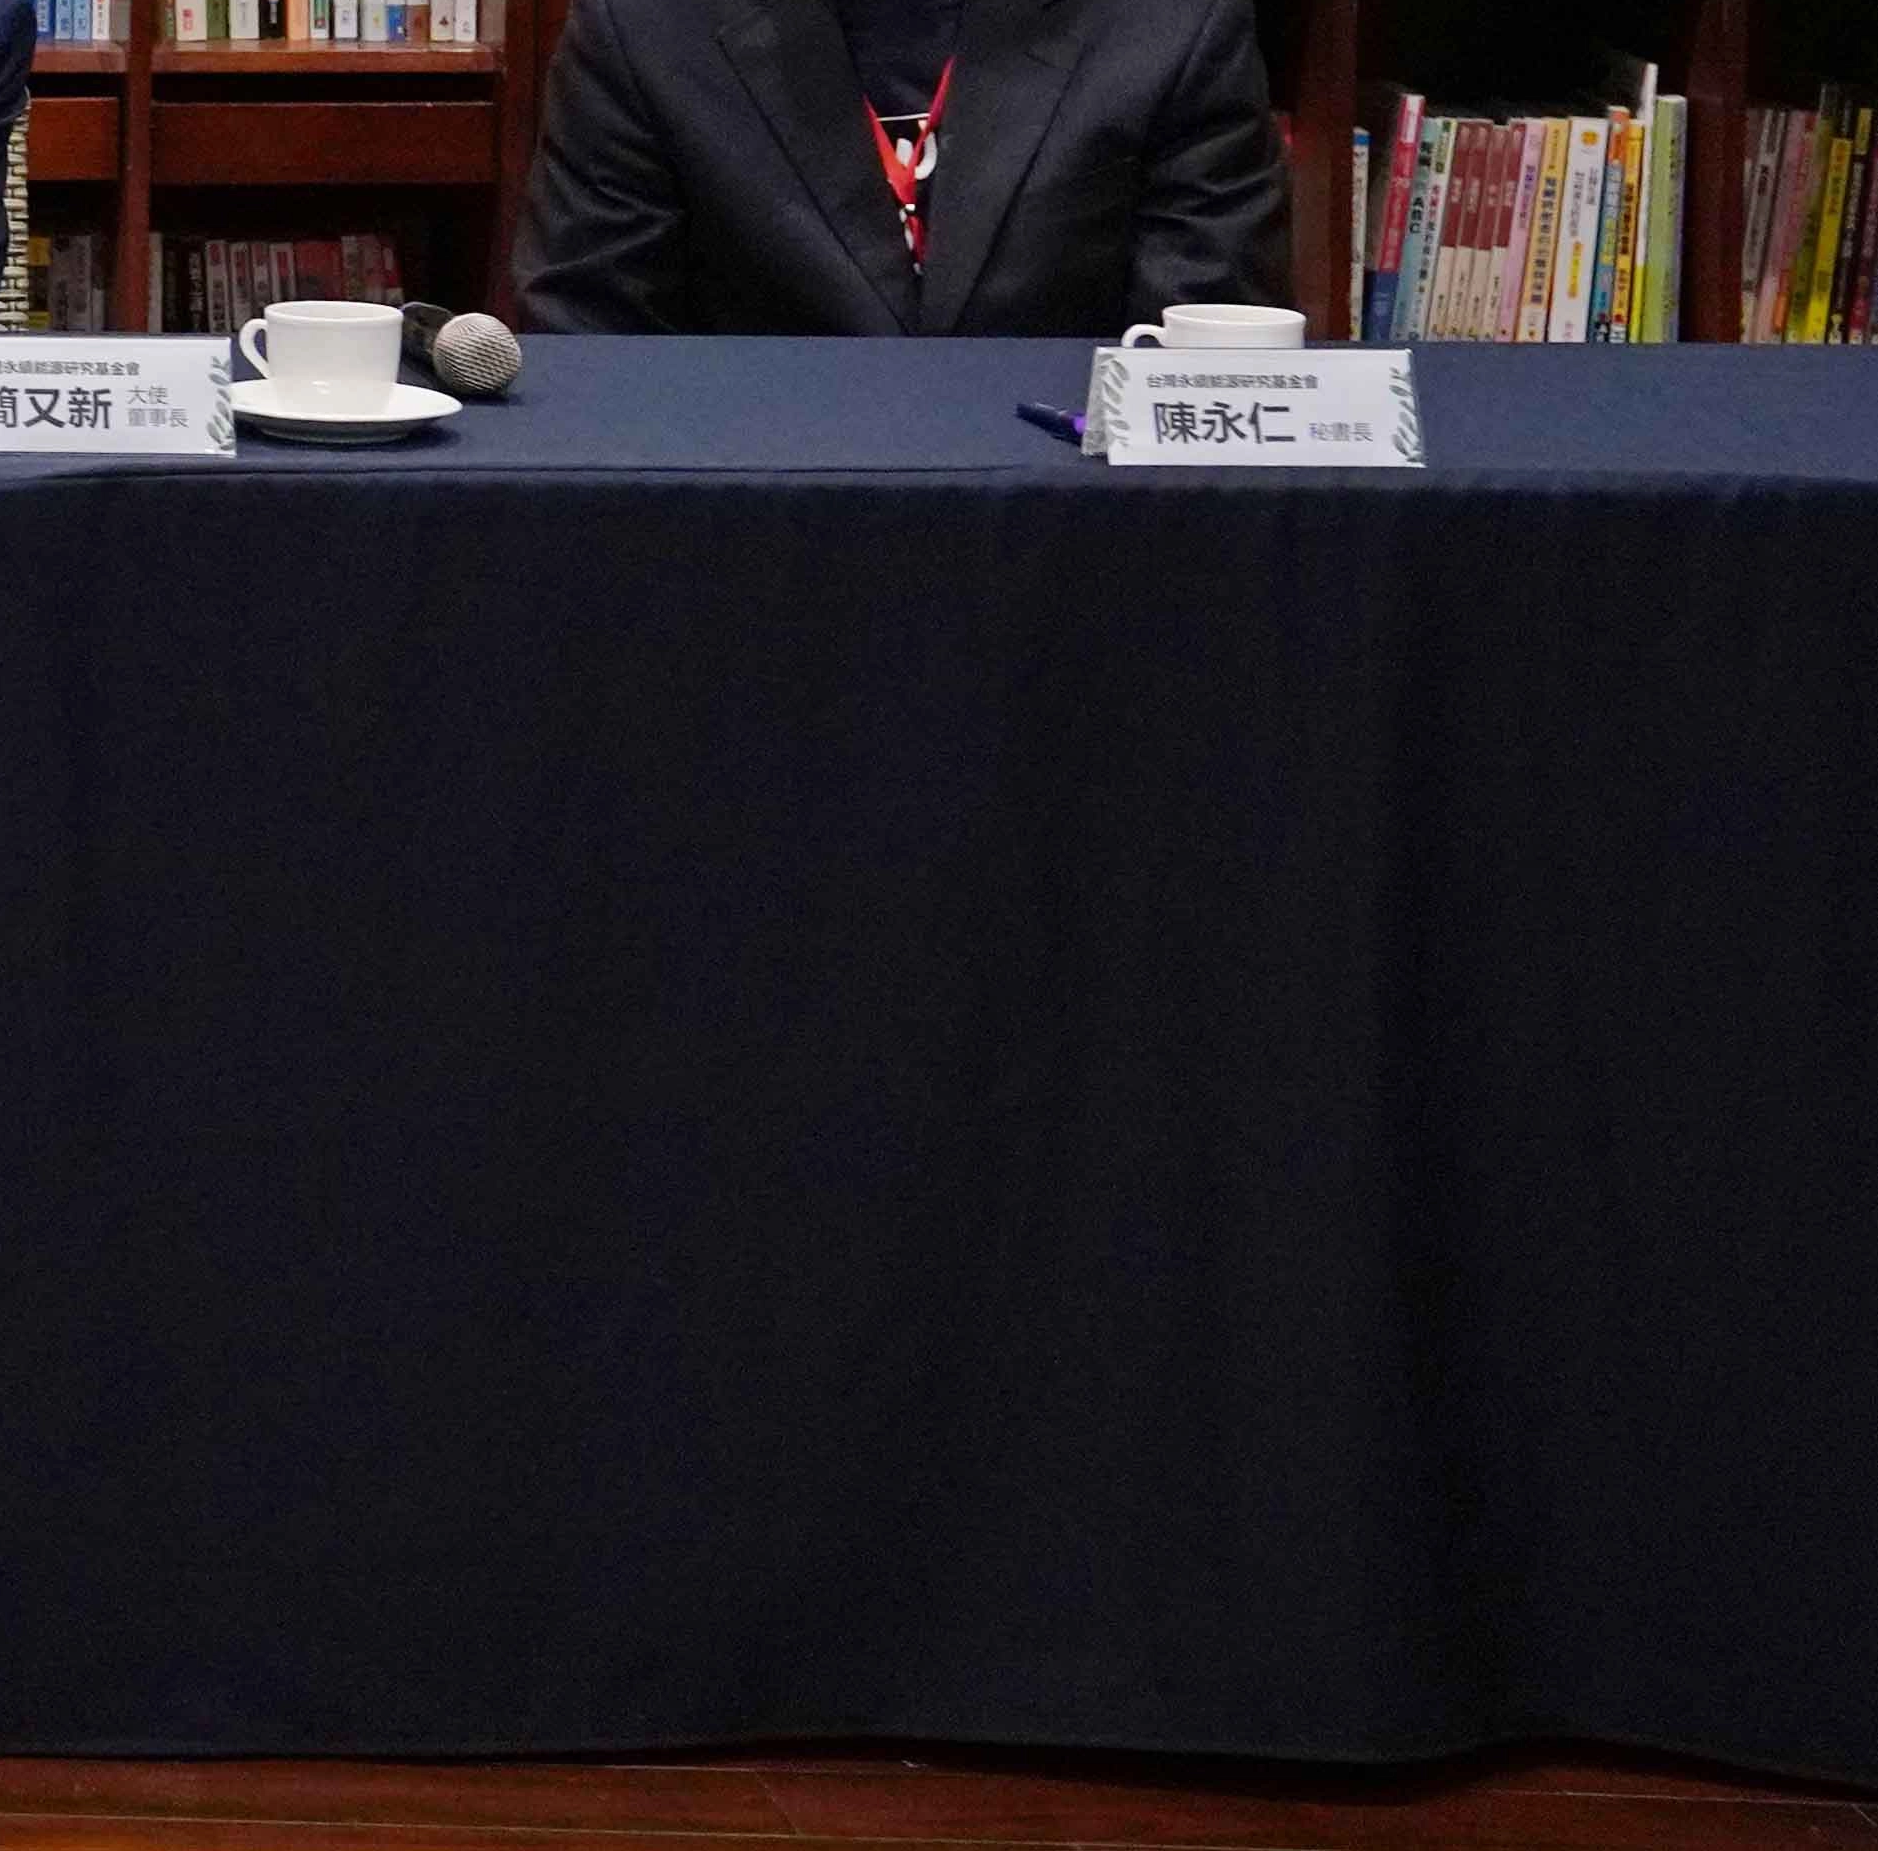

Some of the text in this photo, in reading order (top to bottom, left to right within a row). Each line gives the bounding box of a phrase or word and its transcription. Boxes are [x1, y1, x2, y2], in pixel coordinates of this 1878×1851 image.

[126, 385, 170, 405] 大使
[1152, 401, 1297, 444] 陳永仁
